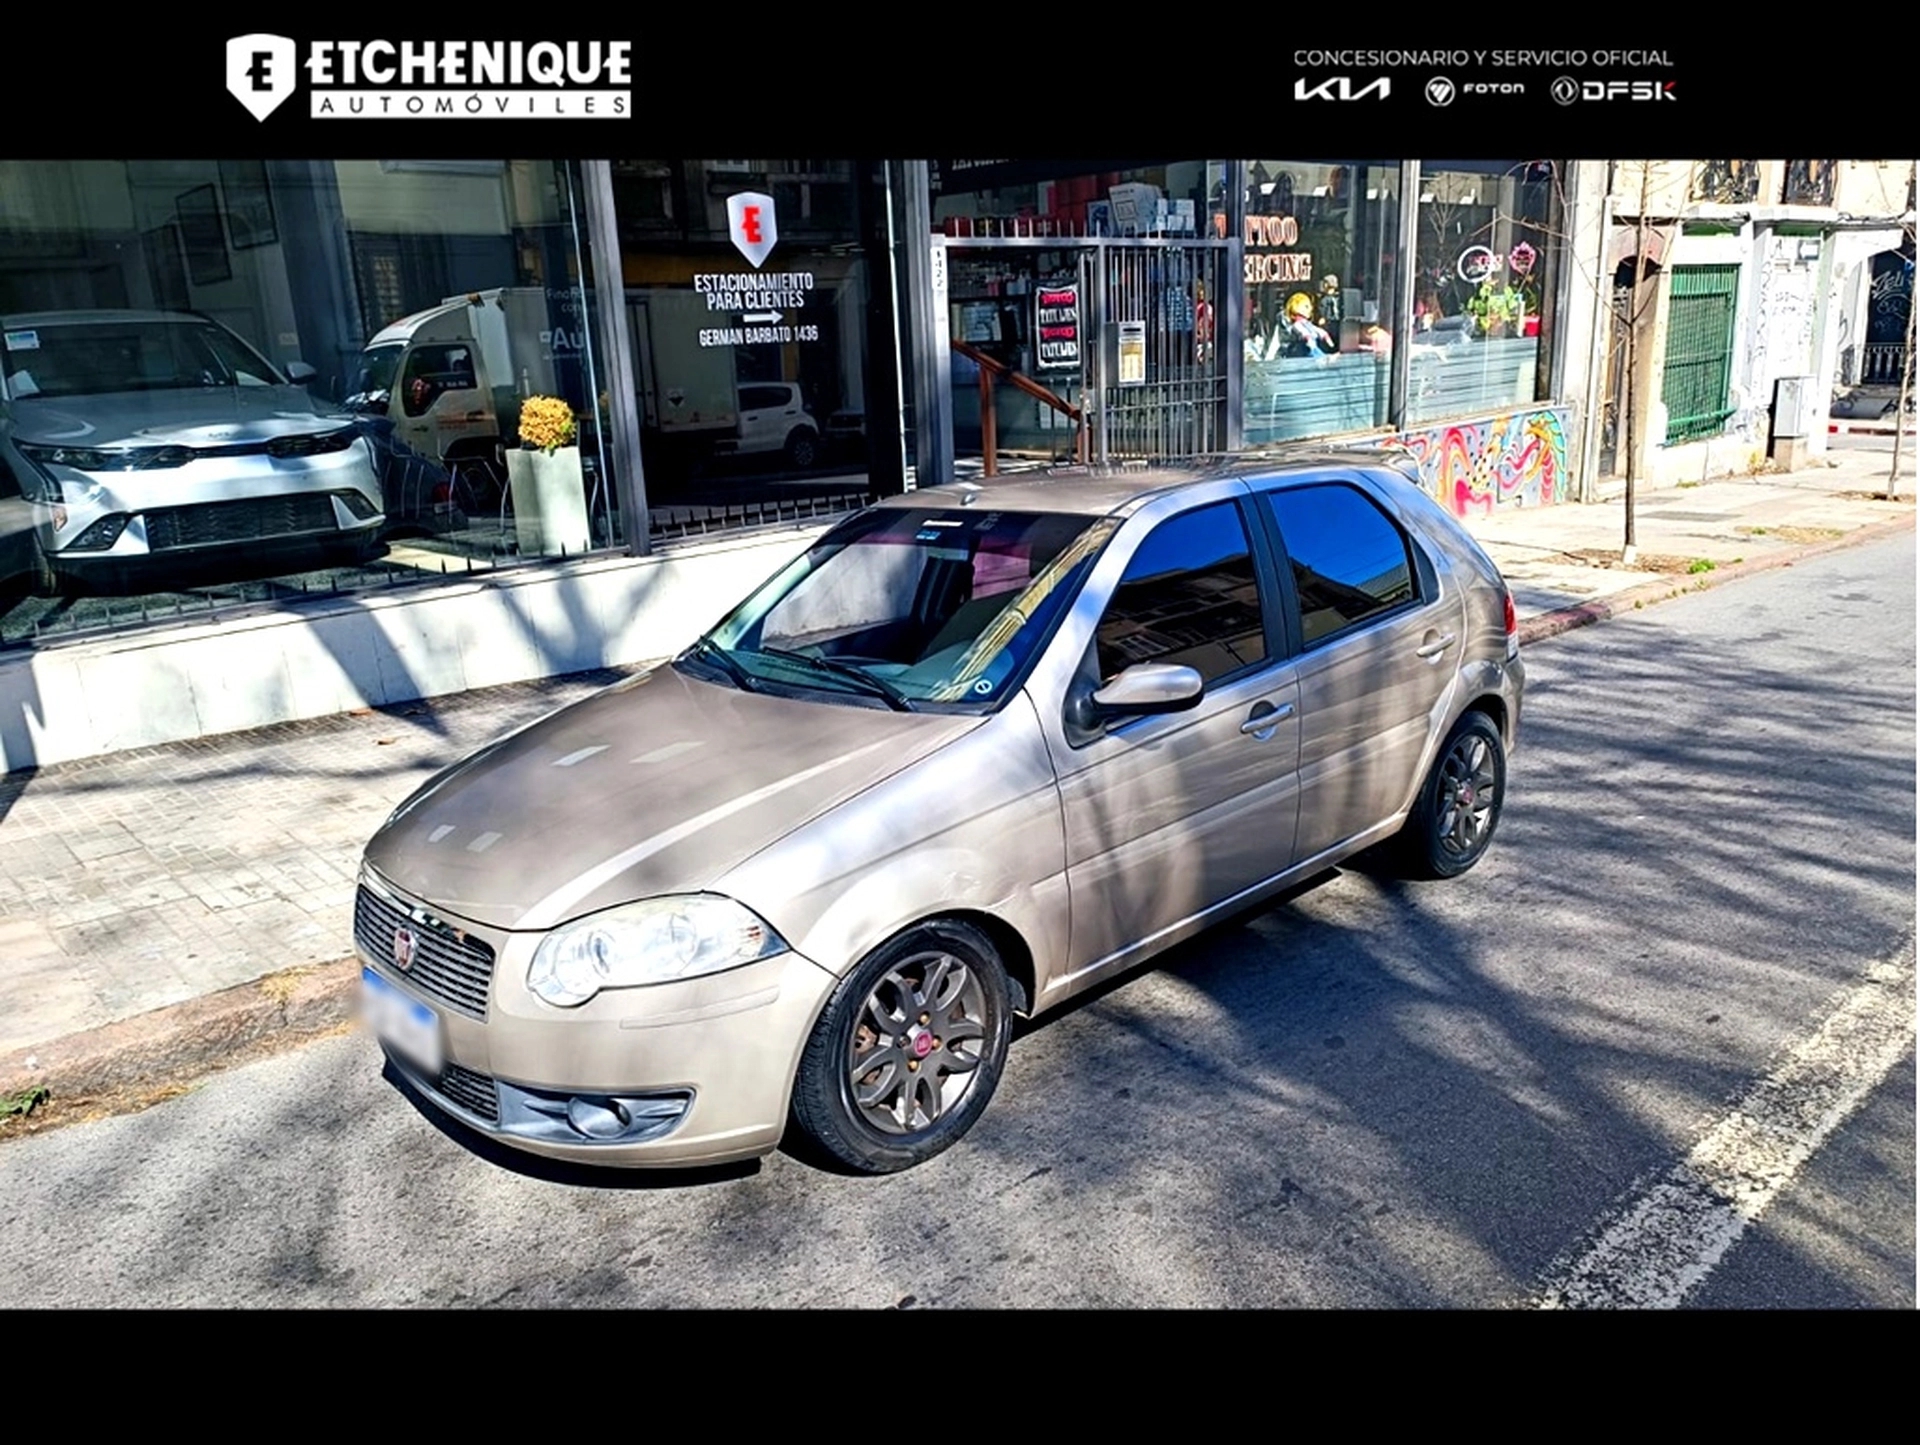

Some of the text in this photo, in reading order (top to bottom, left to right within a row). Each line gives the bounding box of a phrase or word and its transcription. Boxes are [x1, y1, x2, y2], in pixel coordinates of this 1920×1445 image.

[694, 272, 814, 292] ESTACIONAMIENTO
[706, 290, 804, 311] PARA CLIENTES
[699, 328, 744, 347] GERMAN
